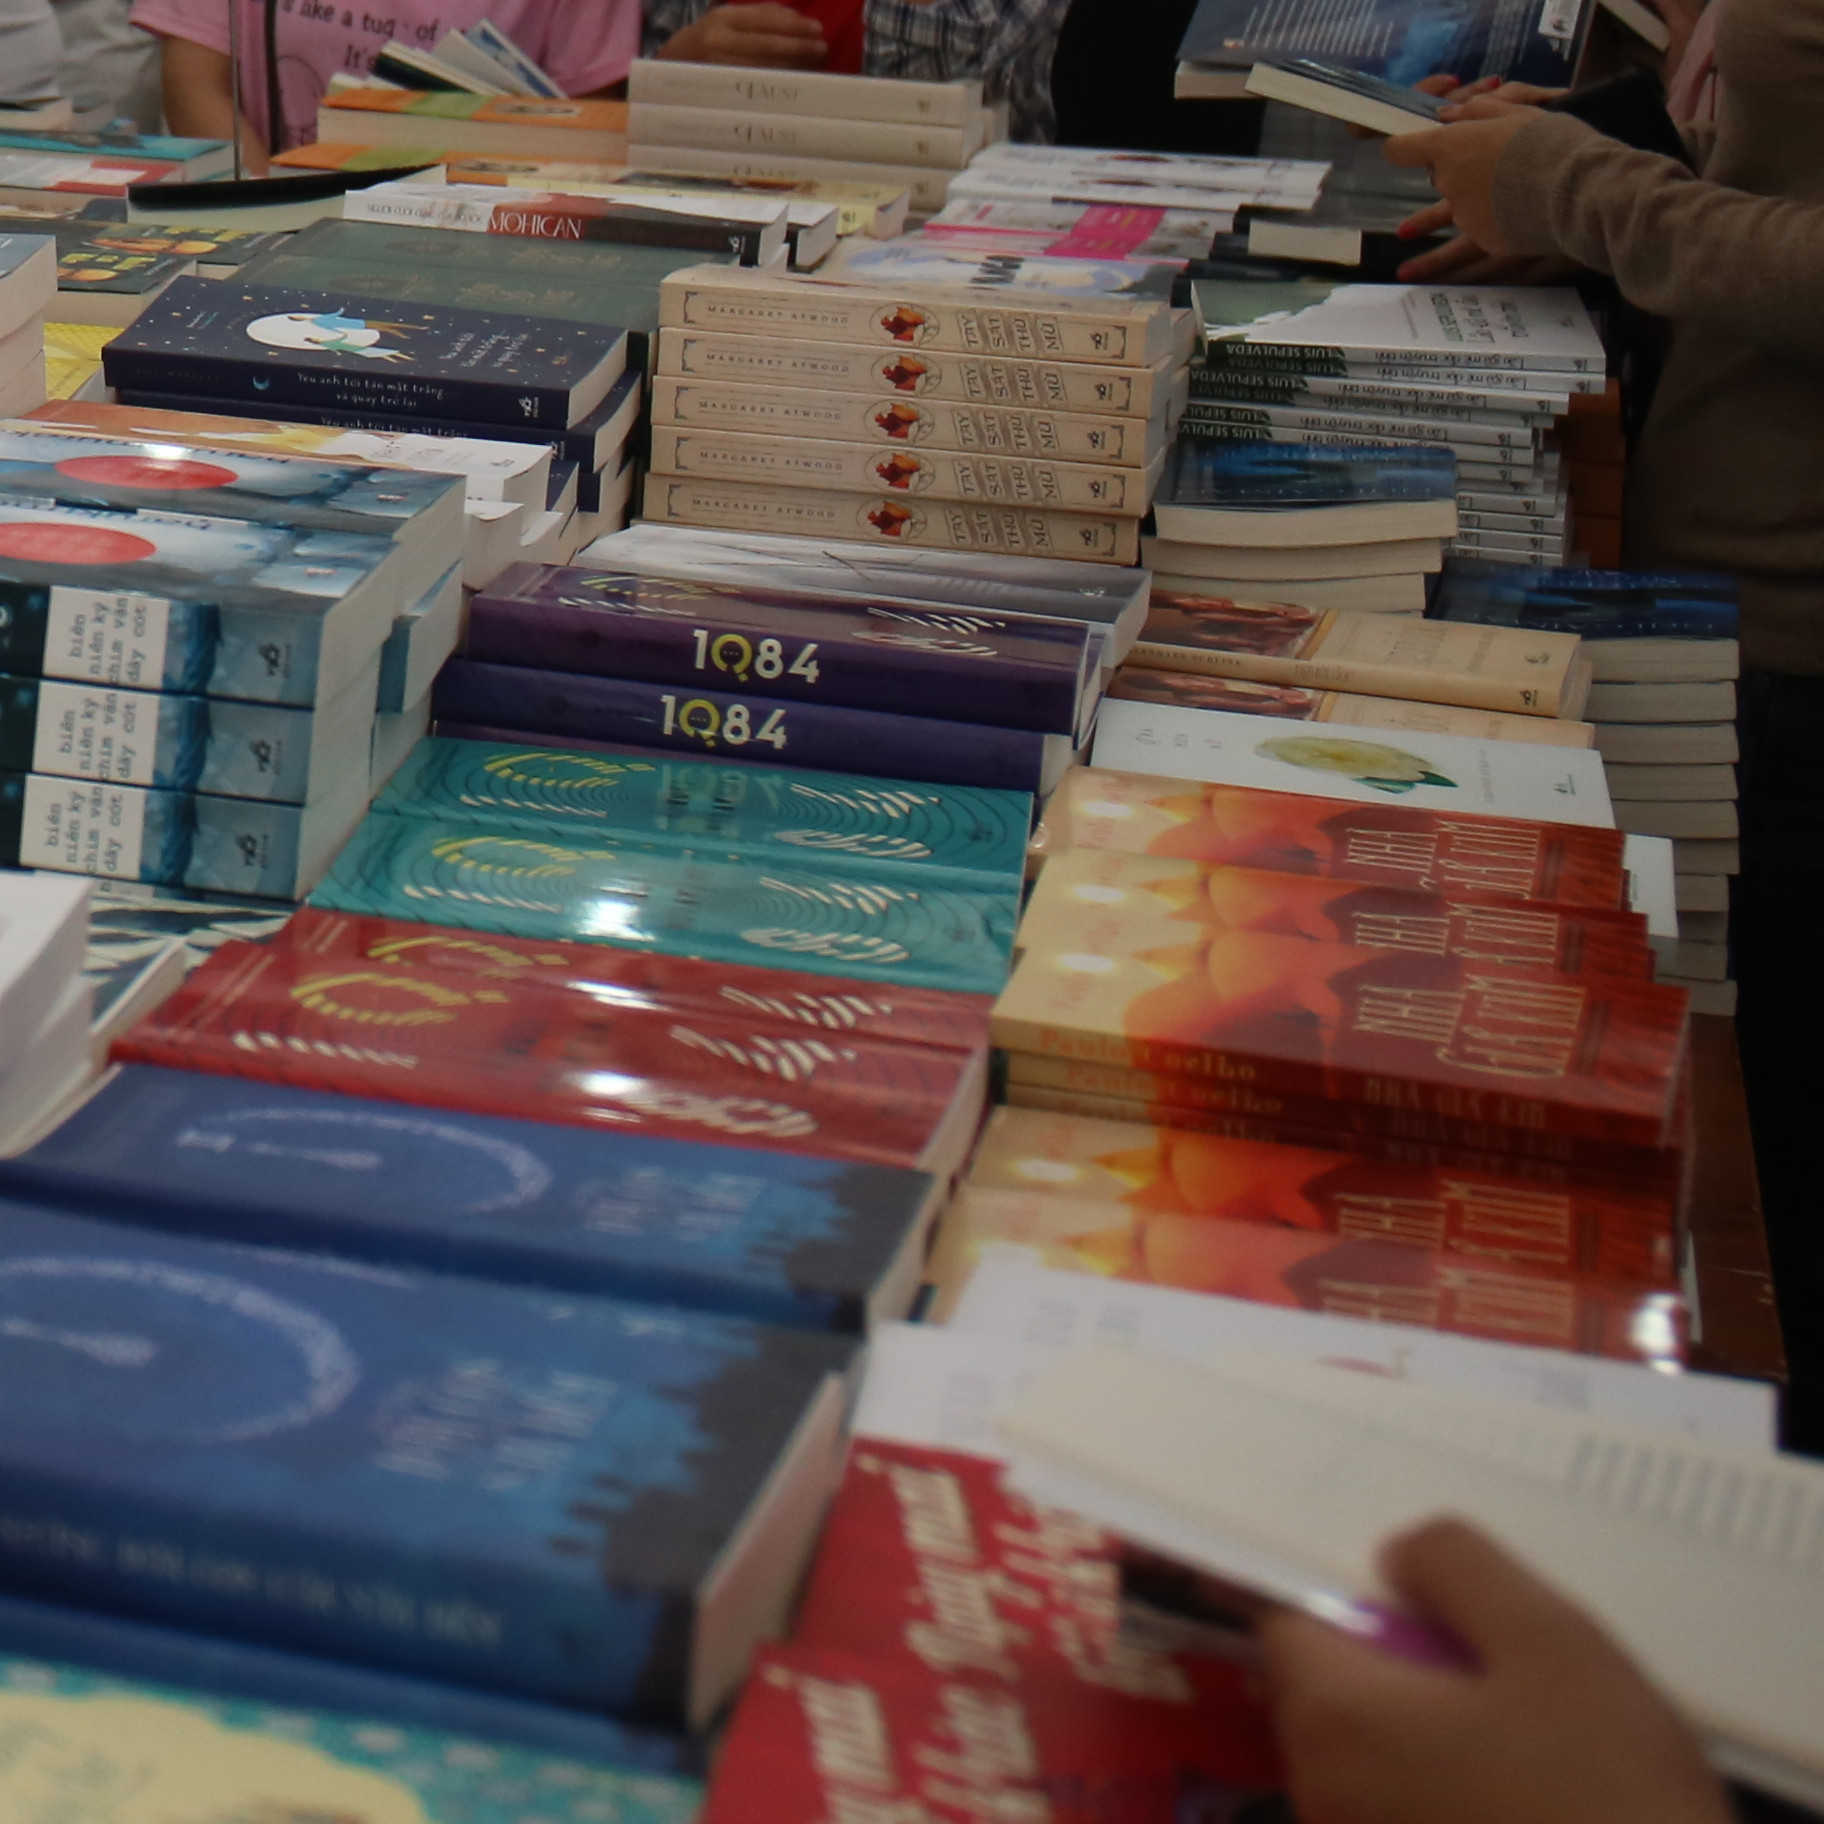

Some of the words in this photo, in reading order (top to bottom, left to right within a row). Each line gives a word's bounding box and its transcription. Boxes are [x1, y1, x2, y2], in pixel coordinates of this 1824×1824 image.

[341, 10, 352, 27] a
[416, 17, 440, 42] of
[489, 213, 582, 239] MOHICAN
[708, 306, 782, 318] MARGARET
[791, 313, 848, 324] ATWOOD
[961, 315, 978, 346] TAY
[706, 354, 781, 366] MARGARET
[791, 362, 849, 372] ATWOOD
[1304, 346, 1332, 358] LUIS
[319, 375, 340, 386] anh
[964, 365, 981, 397] TAY
[699, 401, 774, 414] MARGARET
[784, 409, 841, 420] ATWOOD
[957, 412, 974, 445] TAY
[700, 452, 775, 464] MARGARET
[785, 459, 842, 470] ATWOOD
[958, 463, 975, 494] TAY
[692, 499, 766, 512] MARGARET
[777, 506, 834, 517] ATWOOD
[949, 510, 966, 542] TAY
[693, 629, 820, 683] 1Q84
[661, 695, 787, 749] 1Q84
[1143, 1041, 1258, 1081] Coelho
